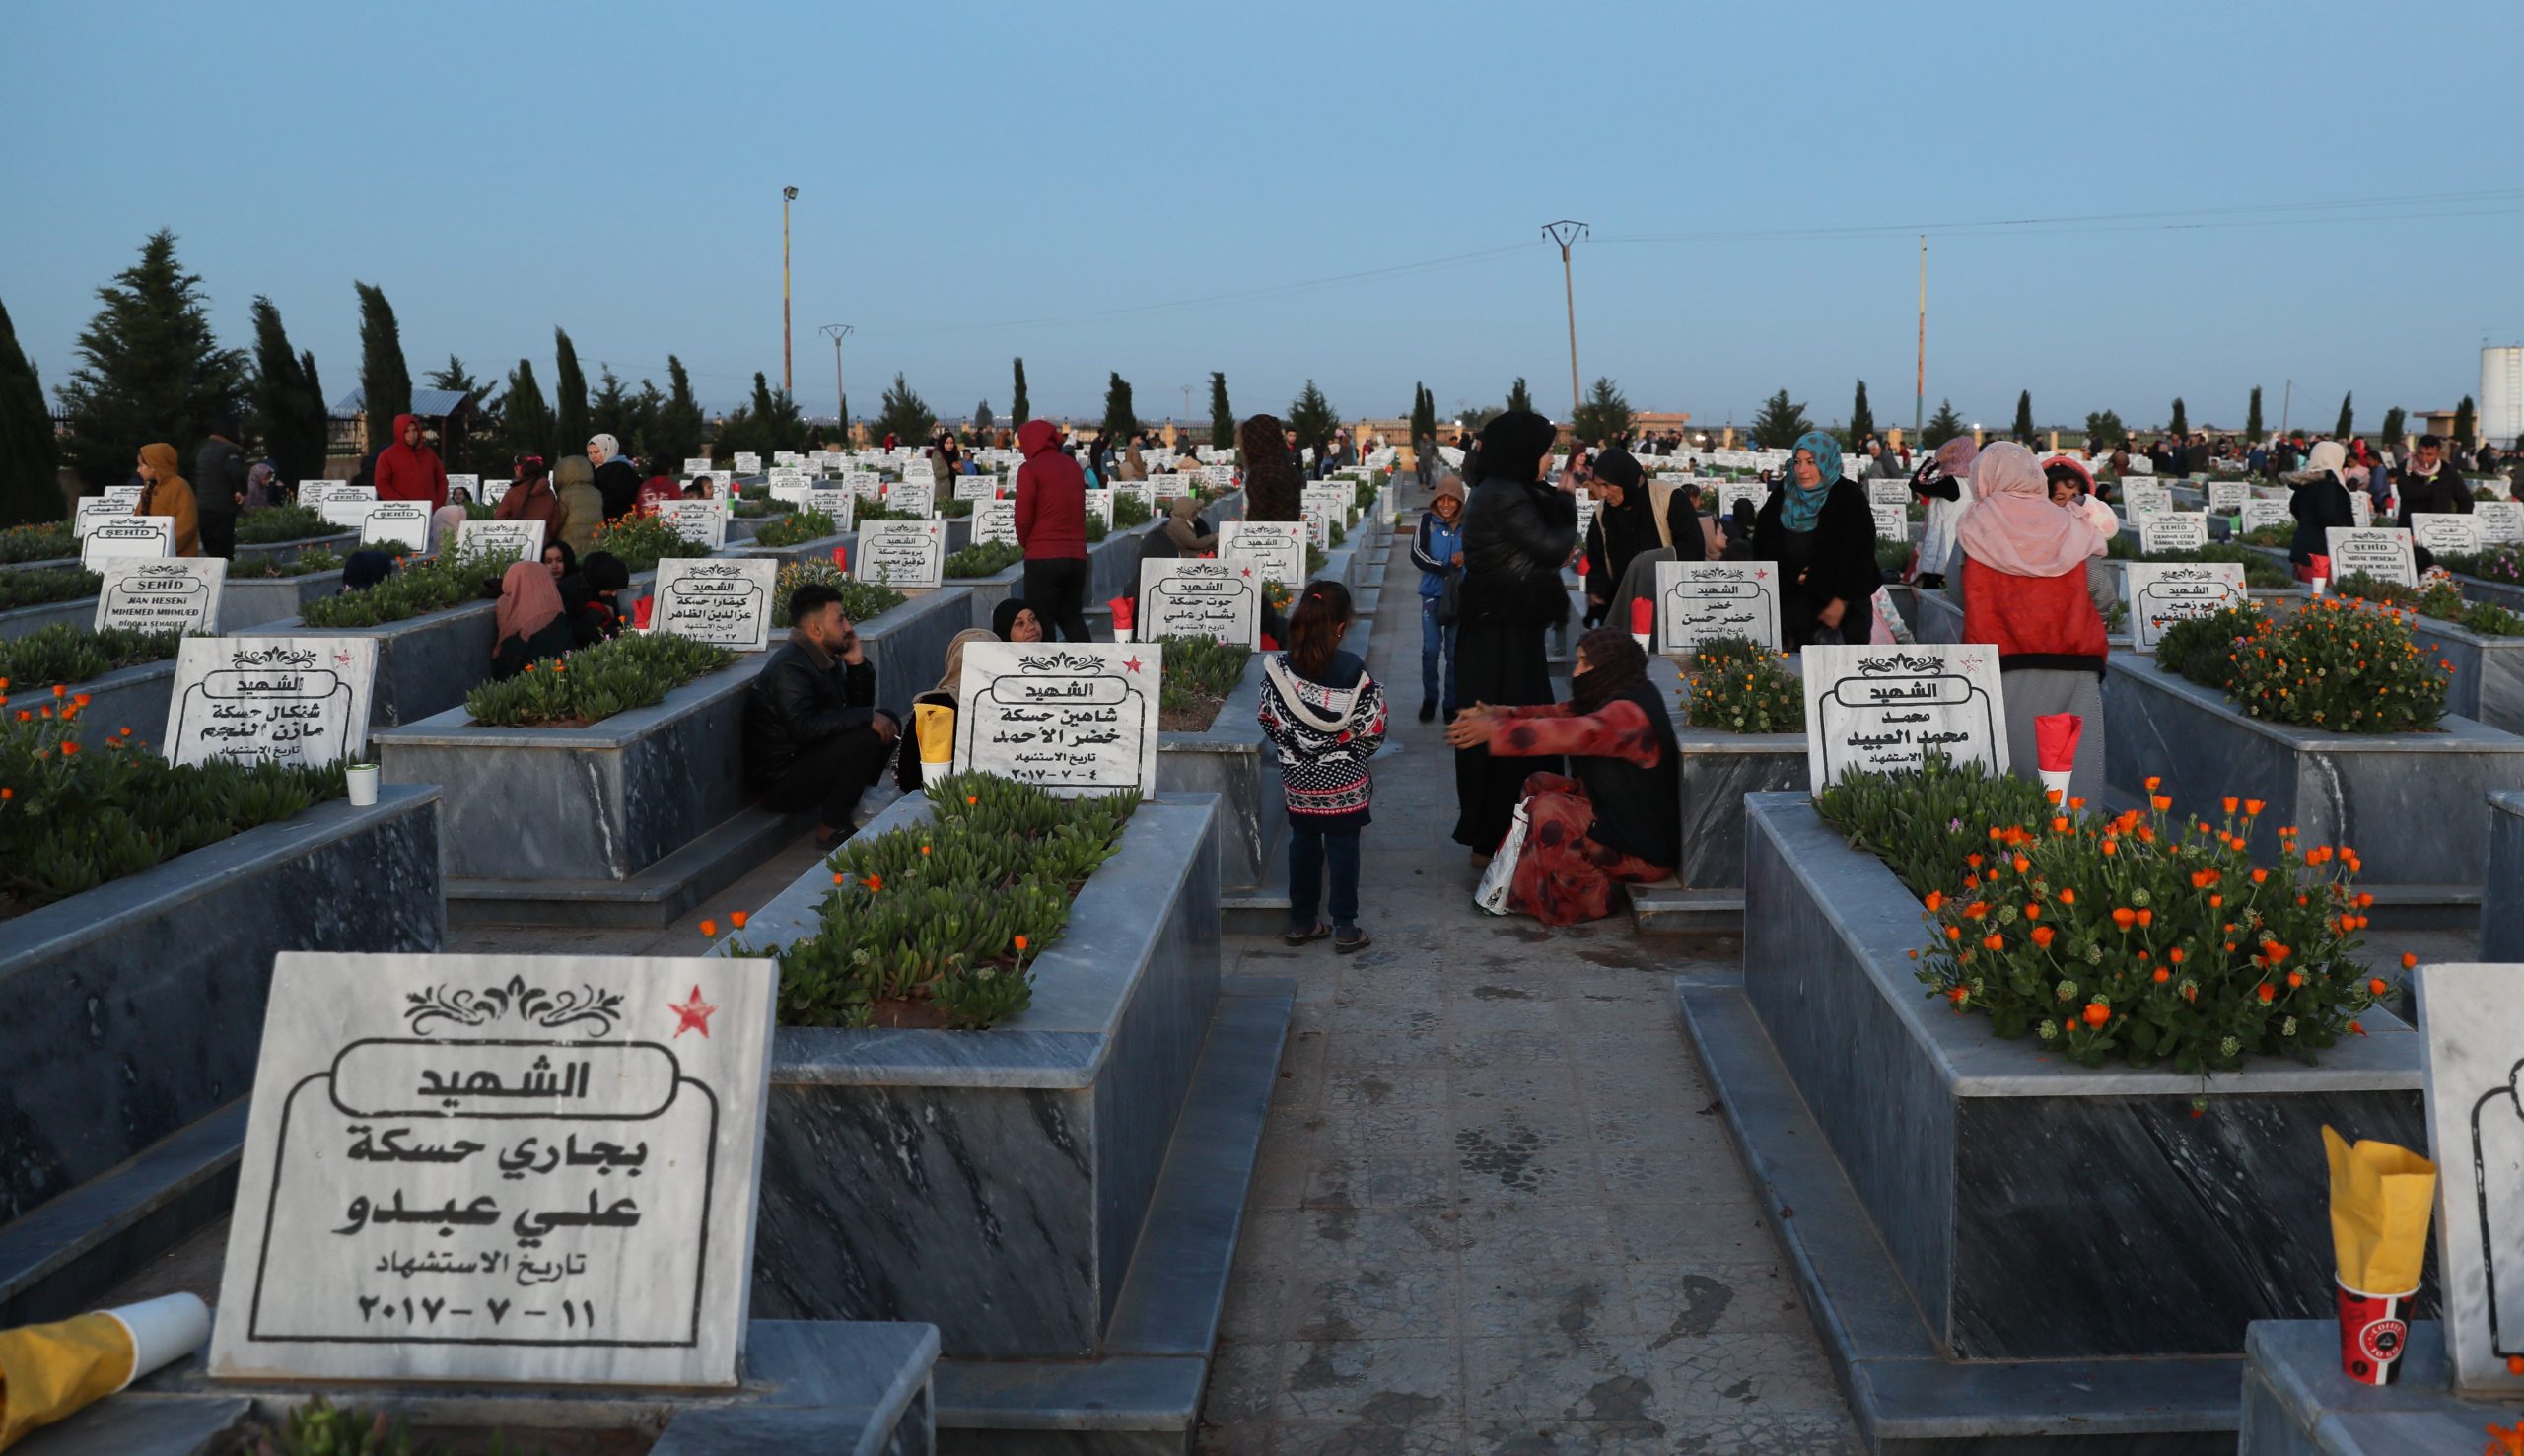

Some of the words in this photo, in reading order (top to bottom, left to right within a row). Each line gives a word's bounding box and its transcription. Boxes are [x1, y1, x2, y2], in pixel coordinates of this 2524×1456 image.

[105, 527, 150, 538] ŞEHÎD
[1247, 538, 1278, 547] الشهيد
[137, 579, 184, 590] ŞEHÎD
[693, 582, 734, 593] الشهيد
[1180, 581, 1223, 593] الشهيد
[1697, 584, 1739, 596] الشهيد
[2168, 585, 2209, 596] الشهيد
[676, 596, 710, 606] حسكة
[1169, 596, 1203, 605] حسكة
[1196, 608, 1236, 623] بشار
[1682, 613, 1717, 625] حسن
[1719, 612, 1755, 625] خضر
[236, 674, 304, 695] الشهيد
[1025, 680, 1094, 701] الشهيد
[1869, 680, 1938, 703] الشهيد
[212, 703, 262, 719] حسكة
[265, 702, 320, 722] شنكال
[1000, 707, 1055, 722] حسكة
[1060, 707, 1117, 727] شاهين
[1881, 711, 1930, 724] محمد
[271, 722, 324, 741] مازن
[1068, 728, 1121, 747] خضر
[1917, 730, 1969, 744] محمد
[1847, 728, 1911, 751] العبيد
[273, 745, 301, 758] تاريخ
[1014, 752, 1067, 764] الاستشهاد
[1069, 753, 1096, 766] تاريخ
[417, 1053, 591, 1108] الشهيد
[347, 1124, 486, 1164] حسكة
[498, 1133, 649, 1180] بجاري
[330, 1188, 501, 1237] عبدو
[513, 1188, 642, 1248] علي
[375, 1249, 511, 1276] الاستشهاد
[516, 1252, 587, 1285] تاريخ
